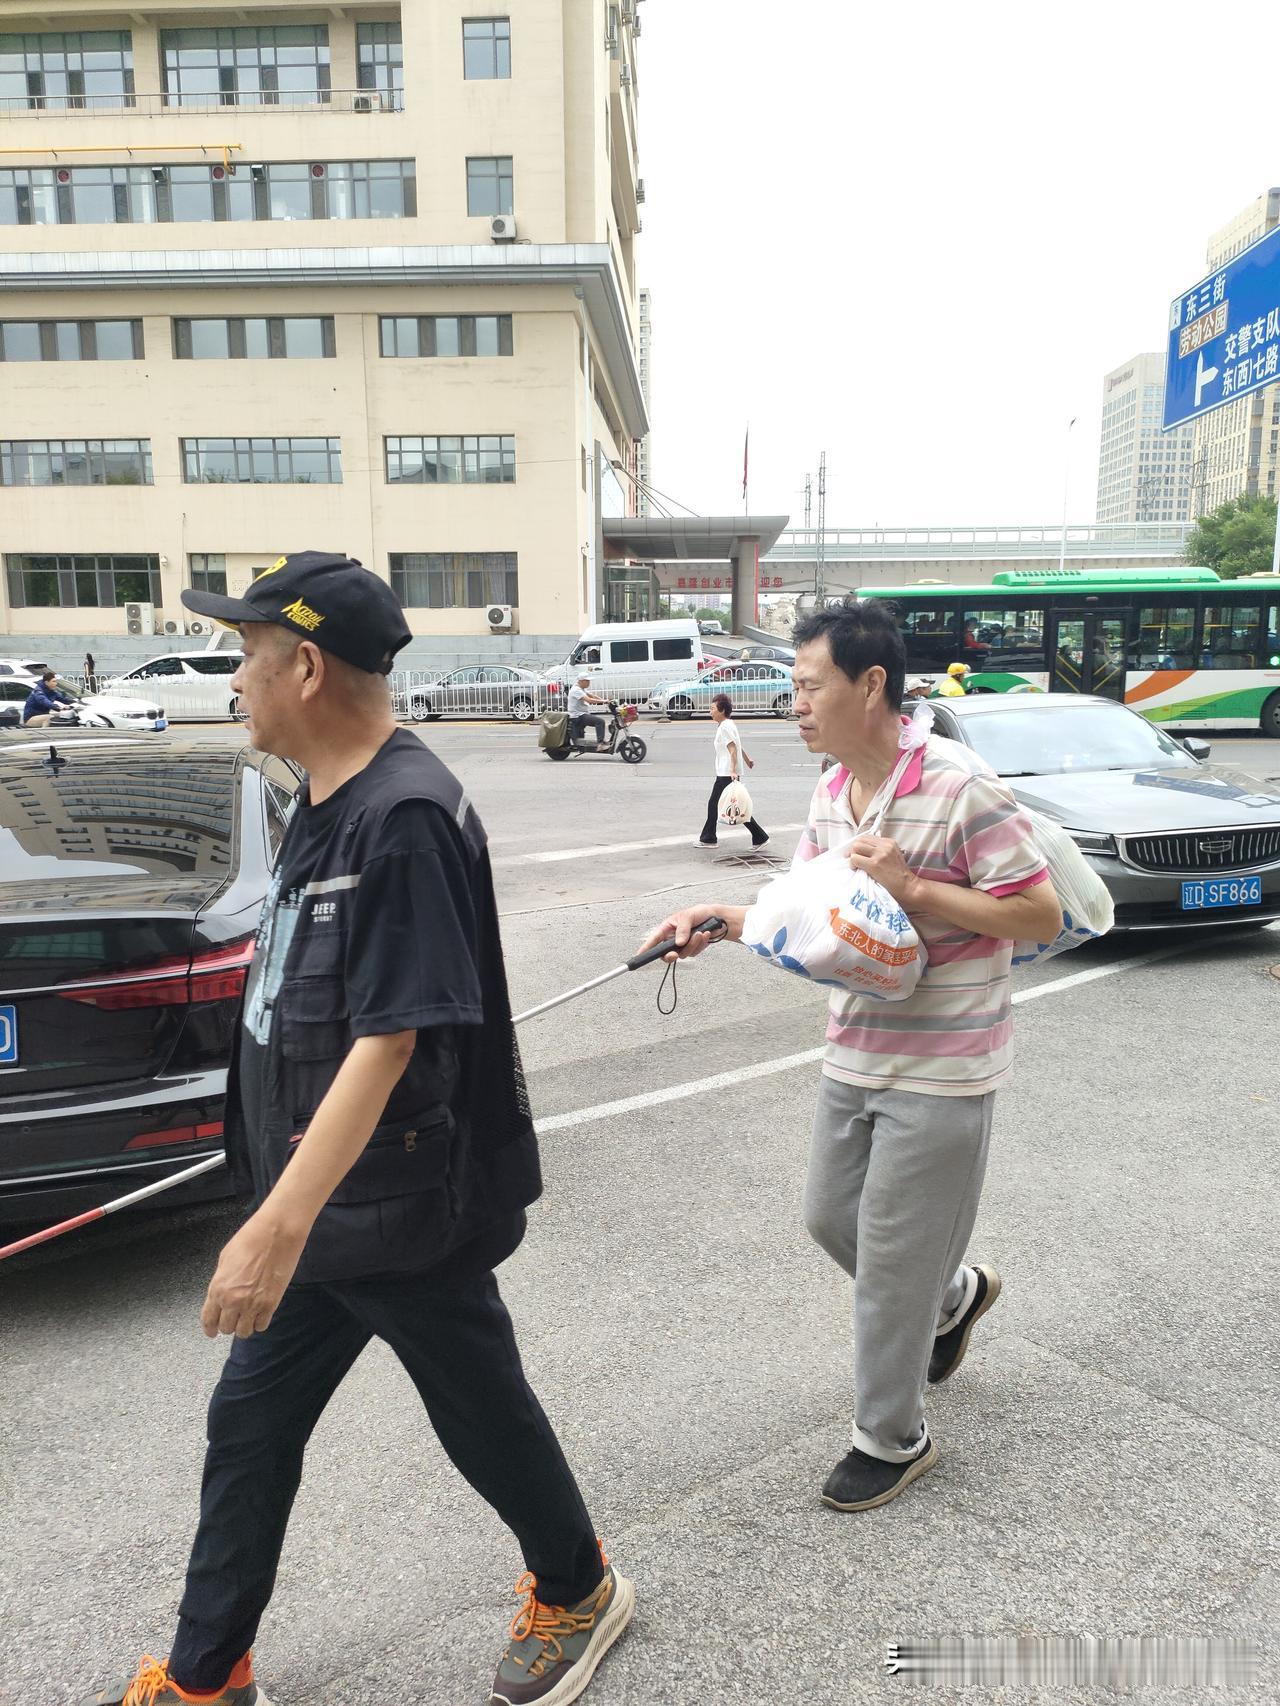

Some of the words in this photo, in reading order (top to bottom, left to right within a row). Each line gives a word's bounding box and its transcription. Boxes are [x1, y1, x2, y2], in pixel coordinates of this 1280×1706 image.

[1185, 273, 1226, 322] 东三街
[1179, 303, 1227, 357] 劳动公园
[1223, 307, 1280, 364] 交警支队
[1222, 343, 1279, 396] 东(西)七路
